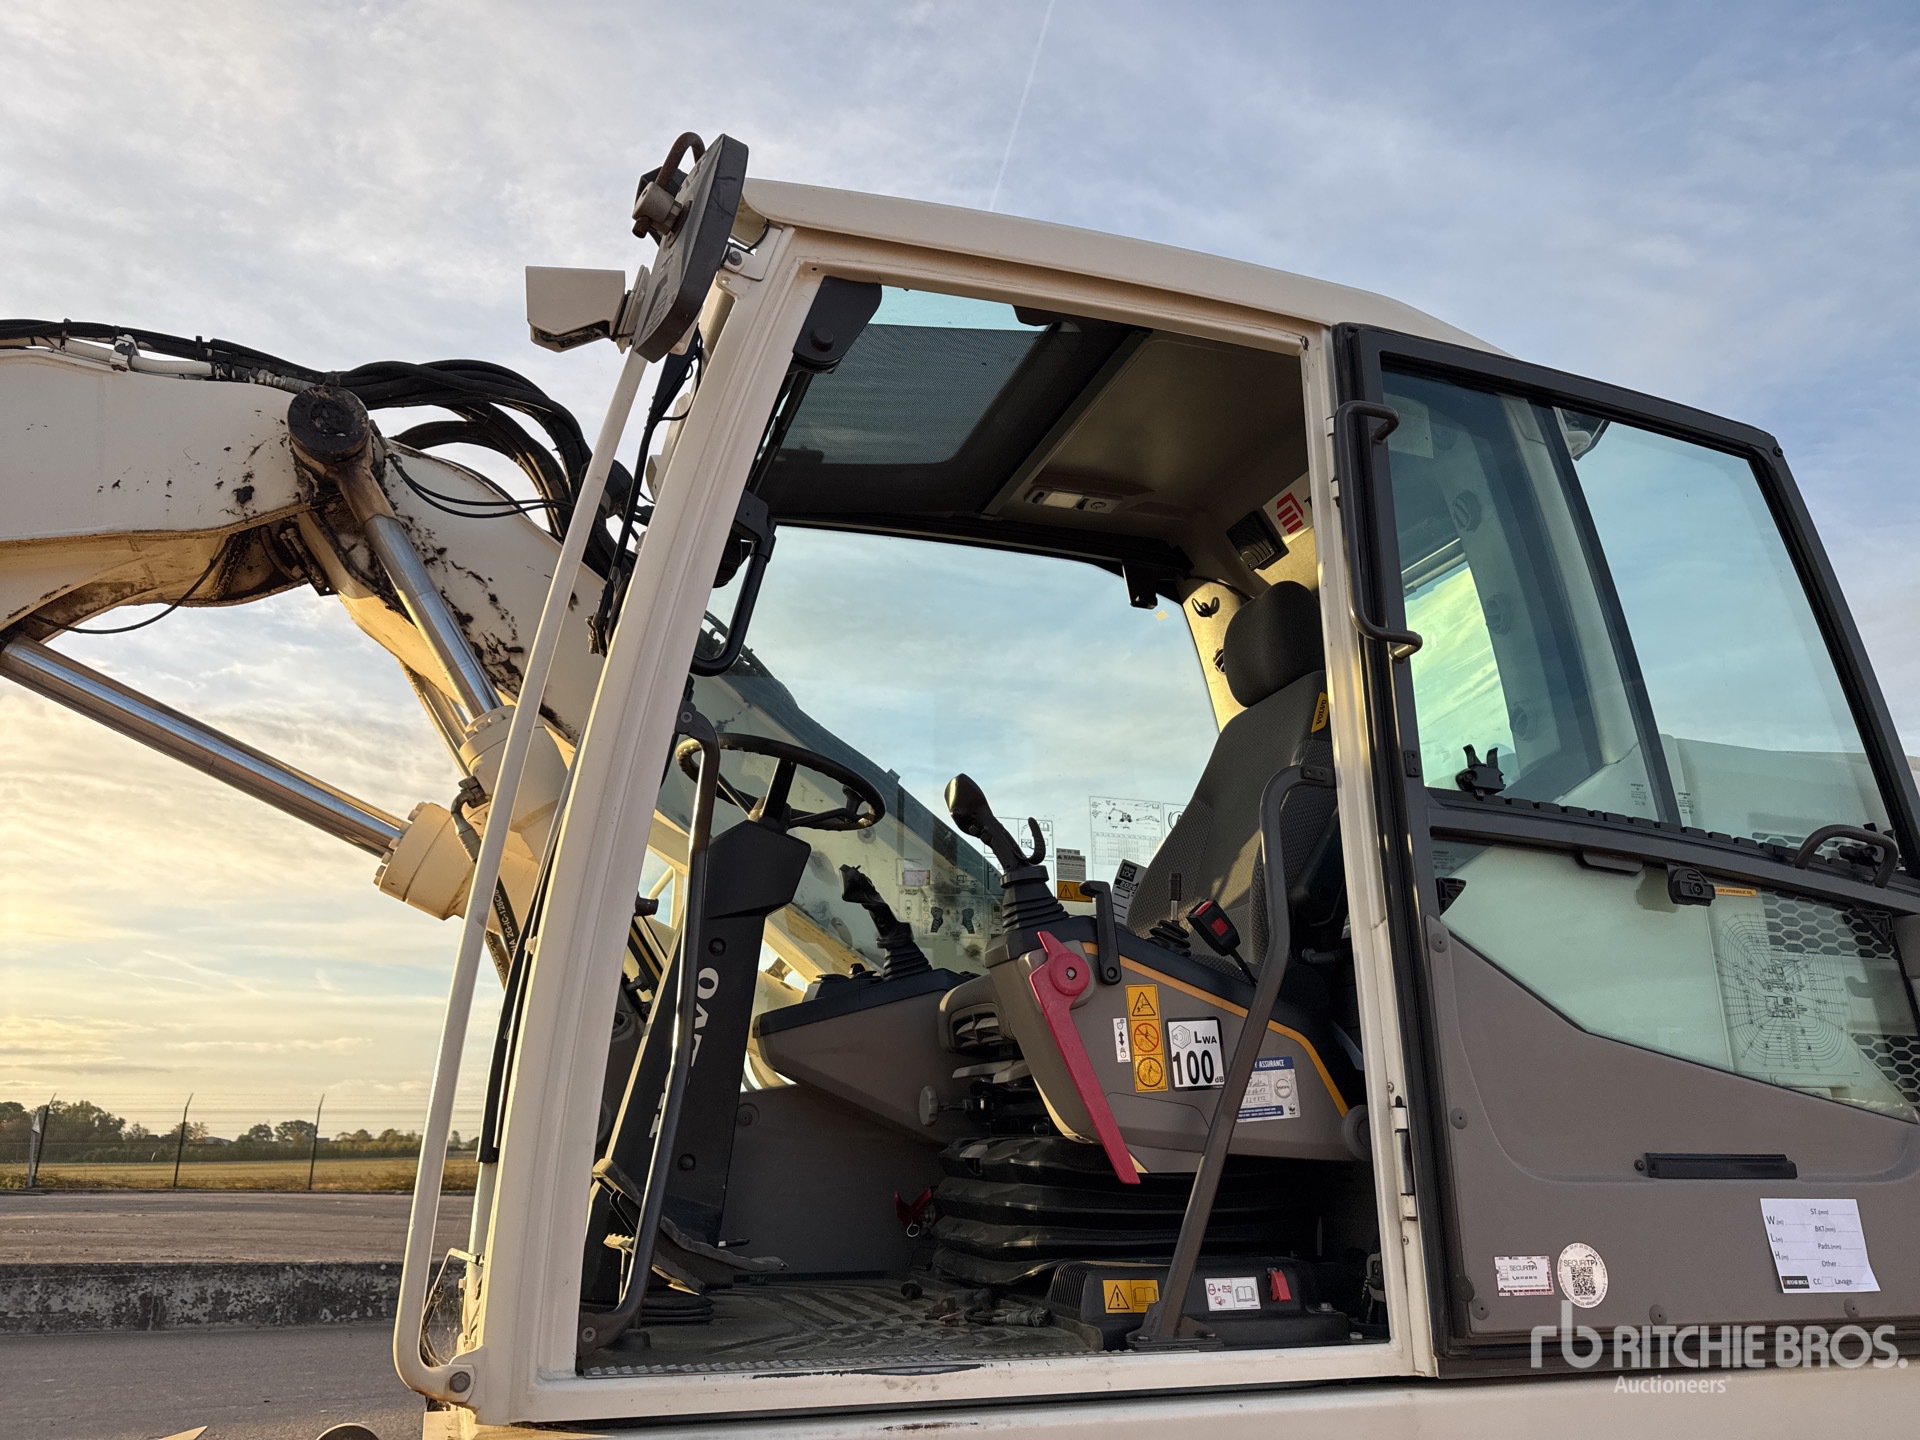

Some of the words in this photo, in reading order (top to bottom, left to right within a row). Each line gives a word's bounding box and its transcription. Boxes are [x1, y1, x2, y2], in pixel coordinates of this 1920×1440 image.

[1316, 700, 1326, 726] VOLVO
[1172, 1050, 1214, 1085] 100
[1258, 1060, 1285, 1068] ASSURANCE
[1834, 1278, 1852, 1286] Lavage
